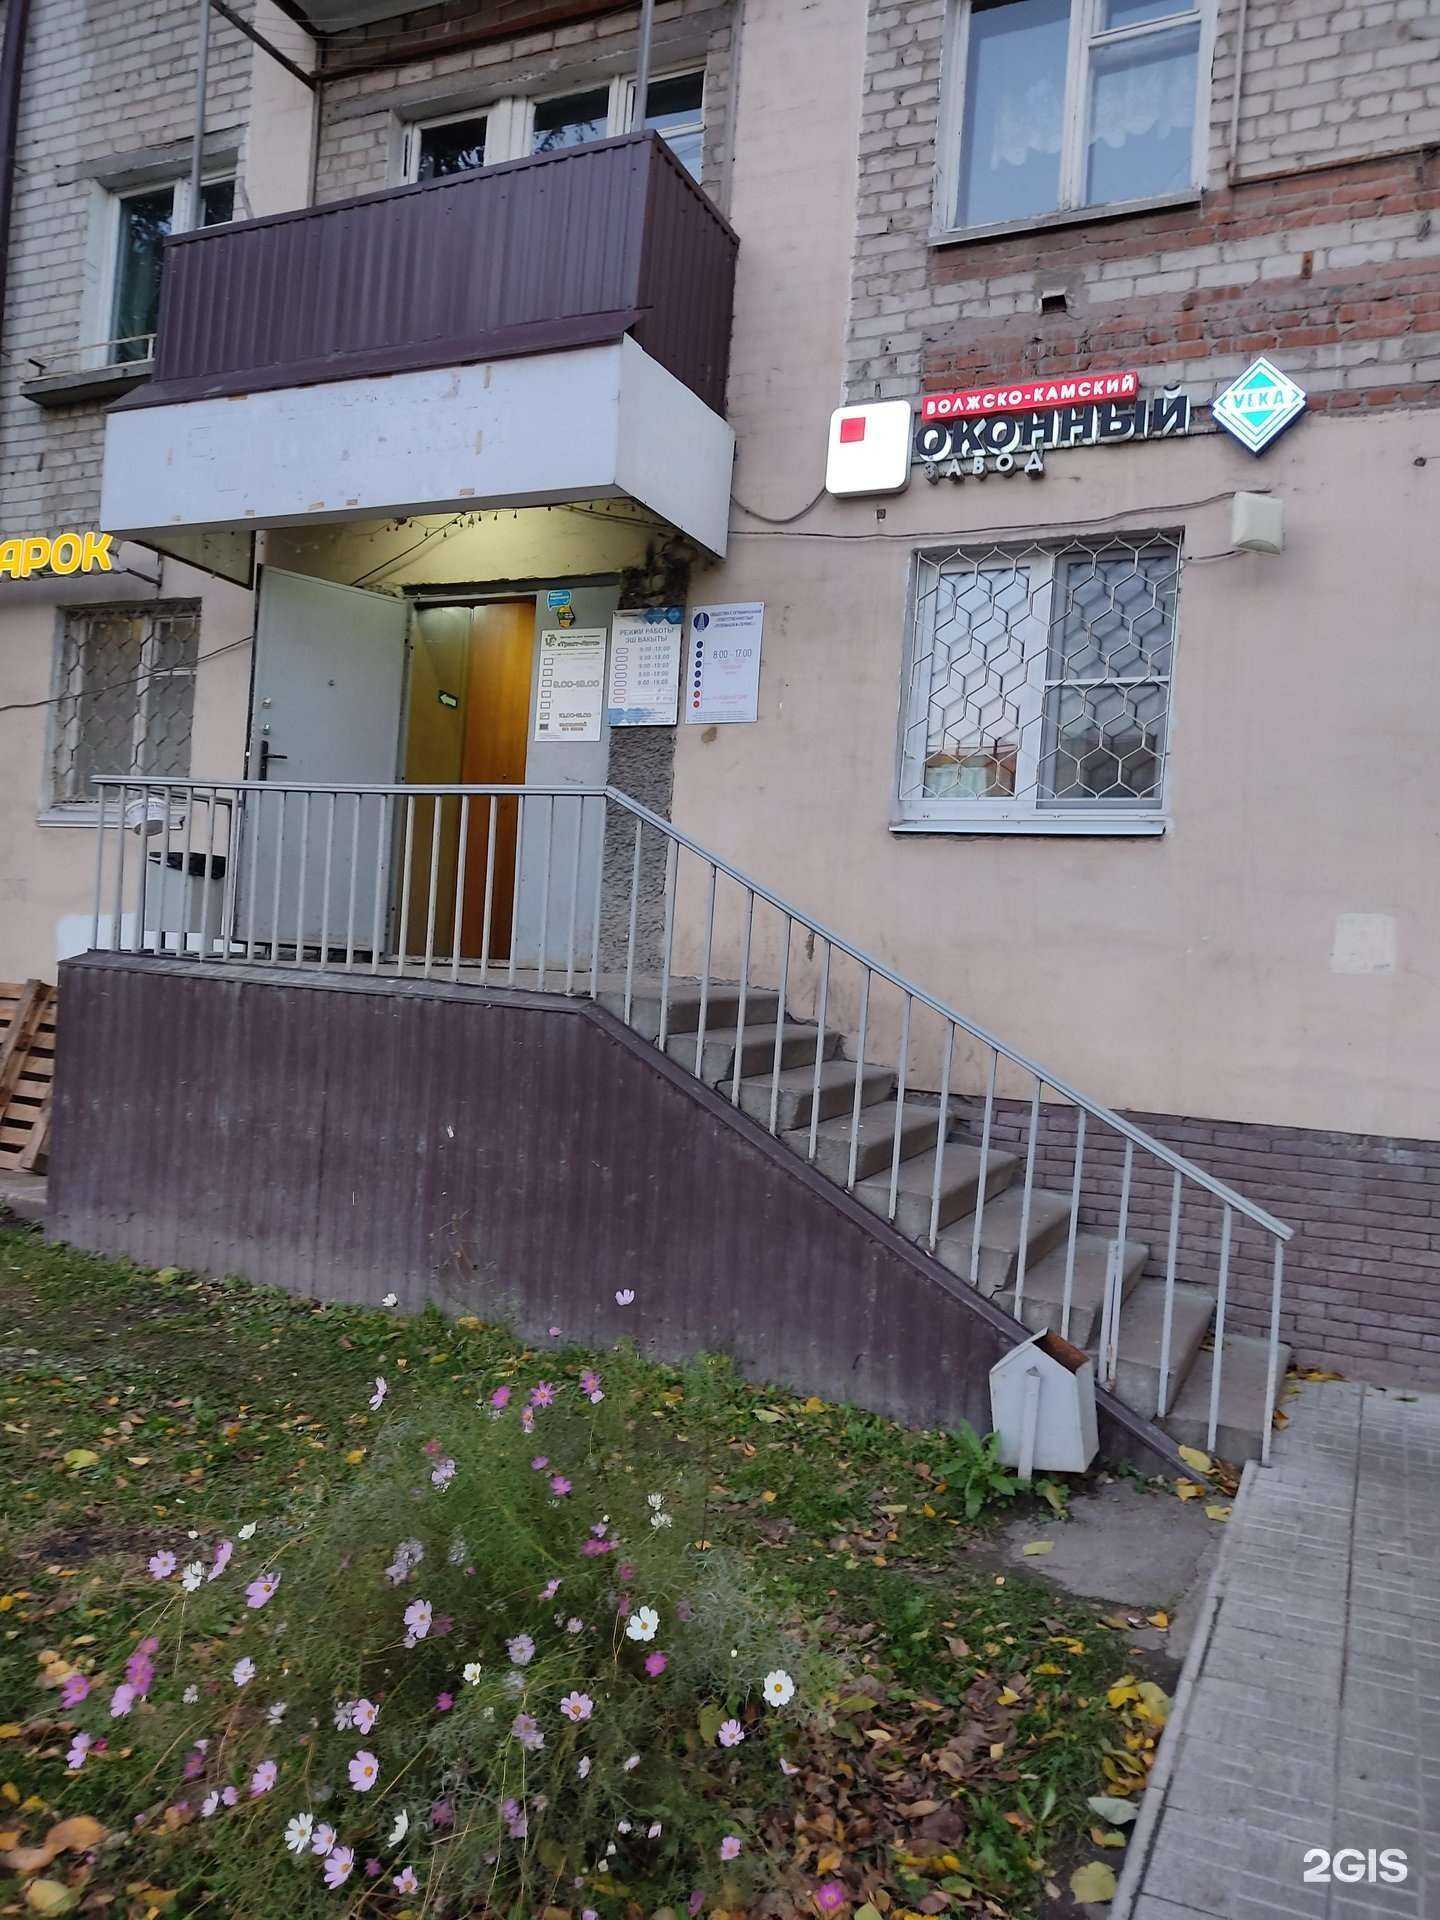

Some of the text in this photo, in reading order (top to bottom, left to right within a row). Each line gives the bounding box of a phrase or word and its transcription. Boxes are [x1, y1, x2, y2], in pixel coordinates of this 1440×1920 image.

[925, 374, 1135, 416] ВОЛЖСКО-КАМСКИЙ
[1233, 390, 1284, 409] VEKA
[914, 384, 1191, 462] ОКОННЫЙ
[923, 450, 1044, 478] ЗАВОД
[0, 532, 113, 578] АРОК
